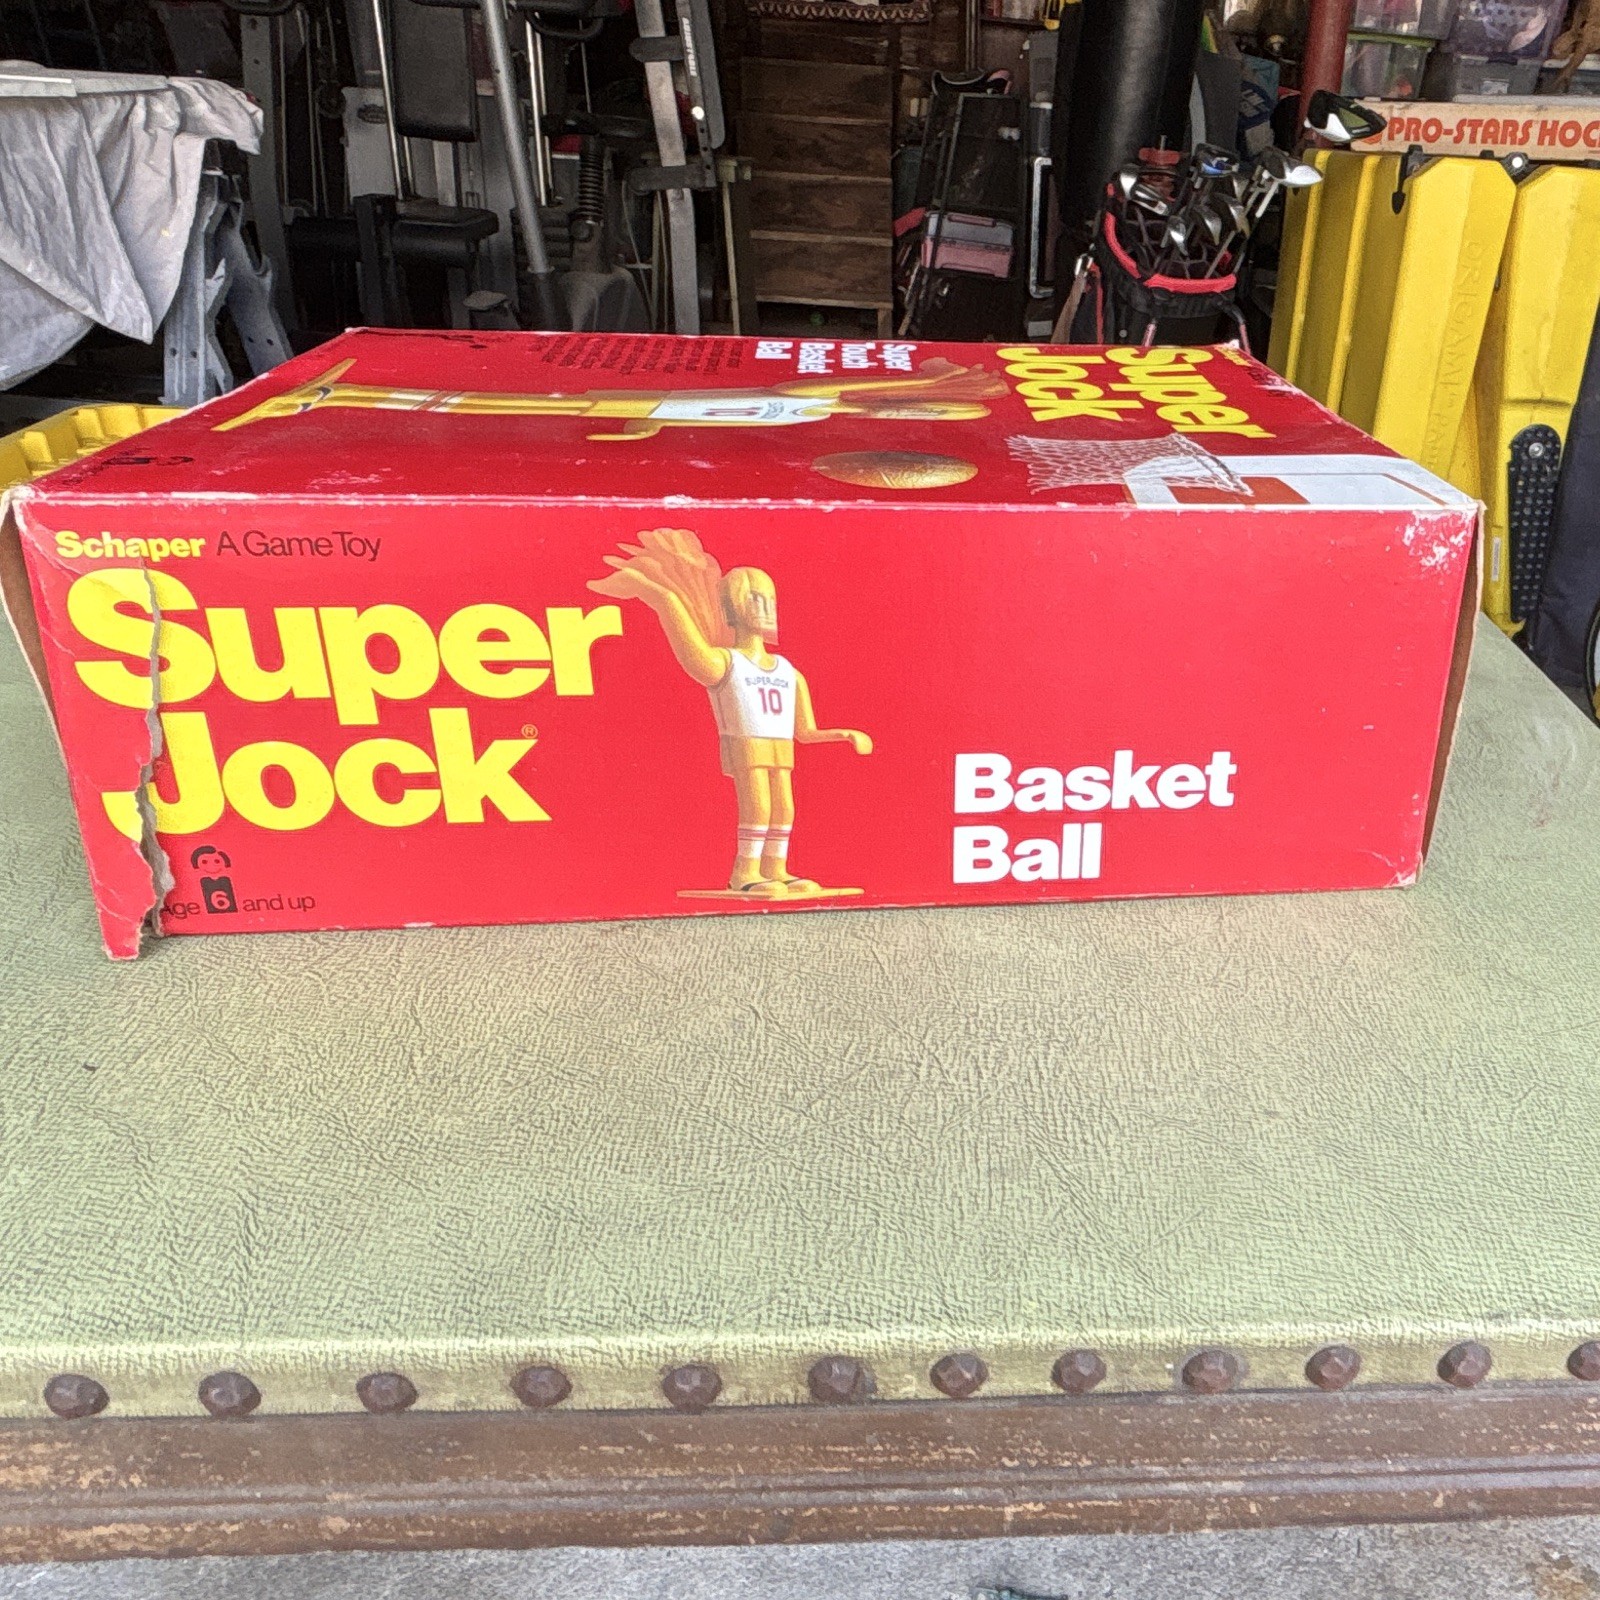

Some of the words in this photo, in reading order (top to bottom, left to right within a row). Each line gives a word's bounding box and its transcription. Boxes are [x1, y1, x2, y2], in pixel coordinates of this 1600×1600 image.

[1387, 117, 1533, 146] PRO-STARS
[1537, 120, 1600, 148] HOC
[755, 341, 794, 360] Ball
[797, 341, 836, 374] Basket
[841, 342, 879, 369] Touch
[876, 343, 918, 372] Super
[996, 347, 1145, 422] Jock
[1107, 347, 1277, 439] Super
[54, 530, 206, 563] Schaper
[216, 531, 241, 556] A
[242, 530, 334, 557] Game
[332, 531, 382, 562] Toy
[67, 567, 624, 726] Super
[758, 687, 783, 715] 10
[954, 750, 1237, 814] Basket
[953, 822, 1103, 884] Ball
[210, 890, 231, 910] 6
[242, 893, 284, 912] and
[287, 895, 316, 912] up
